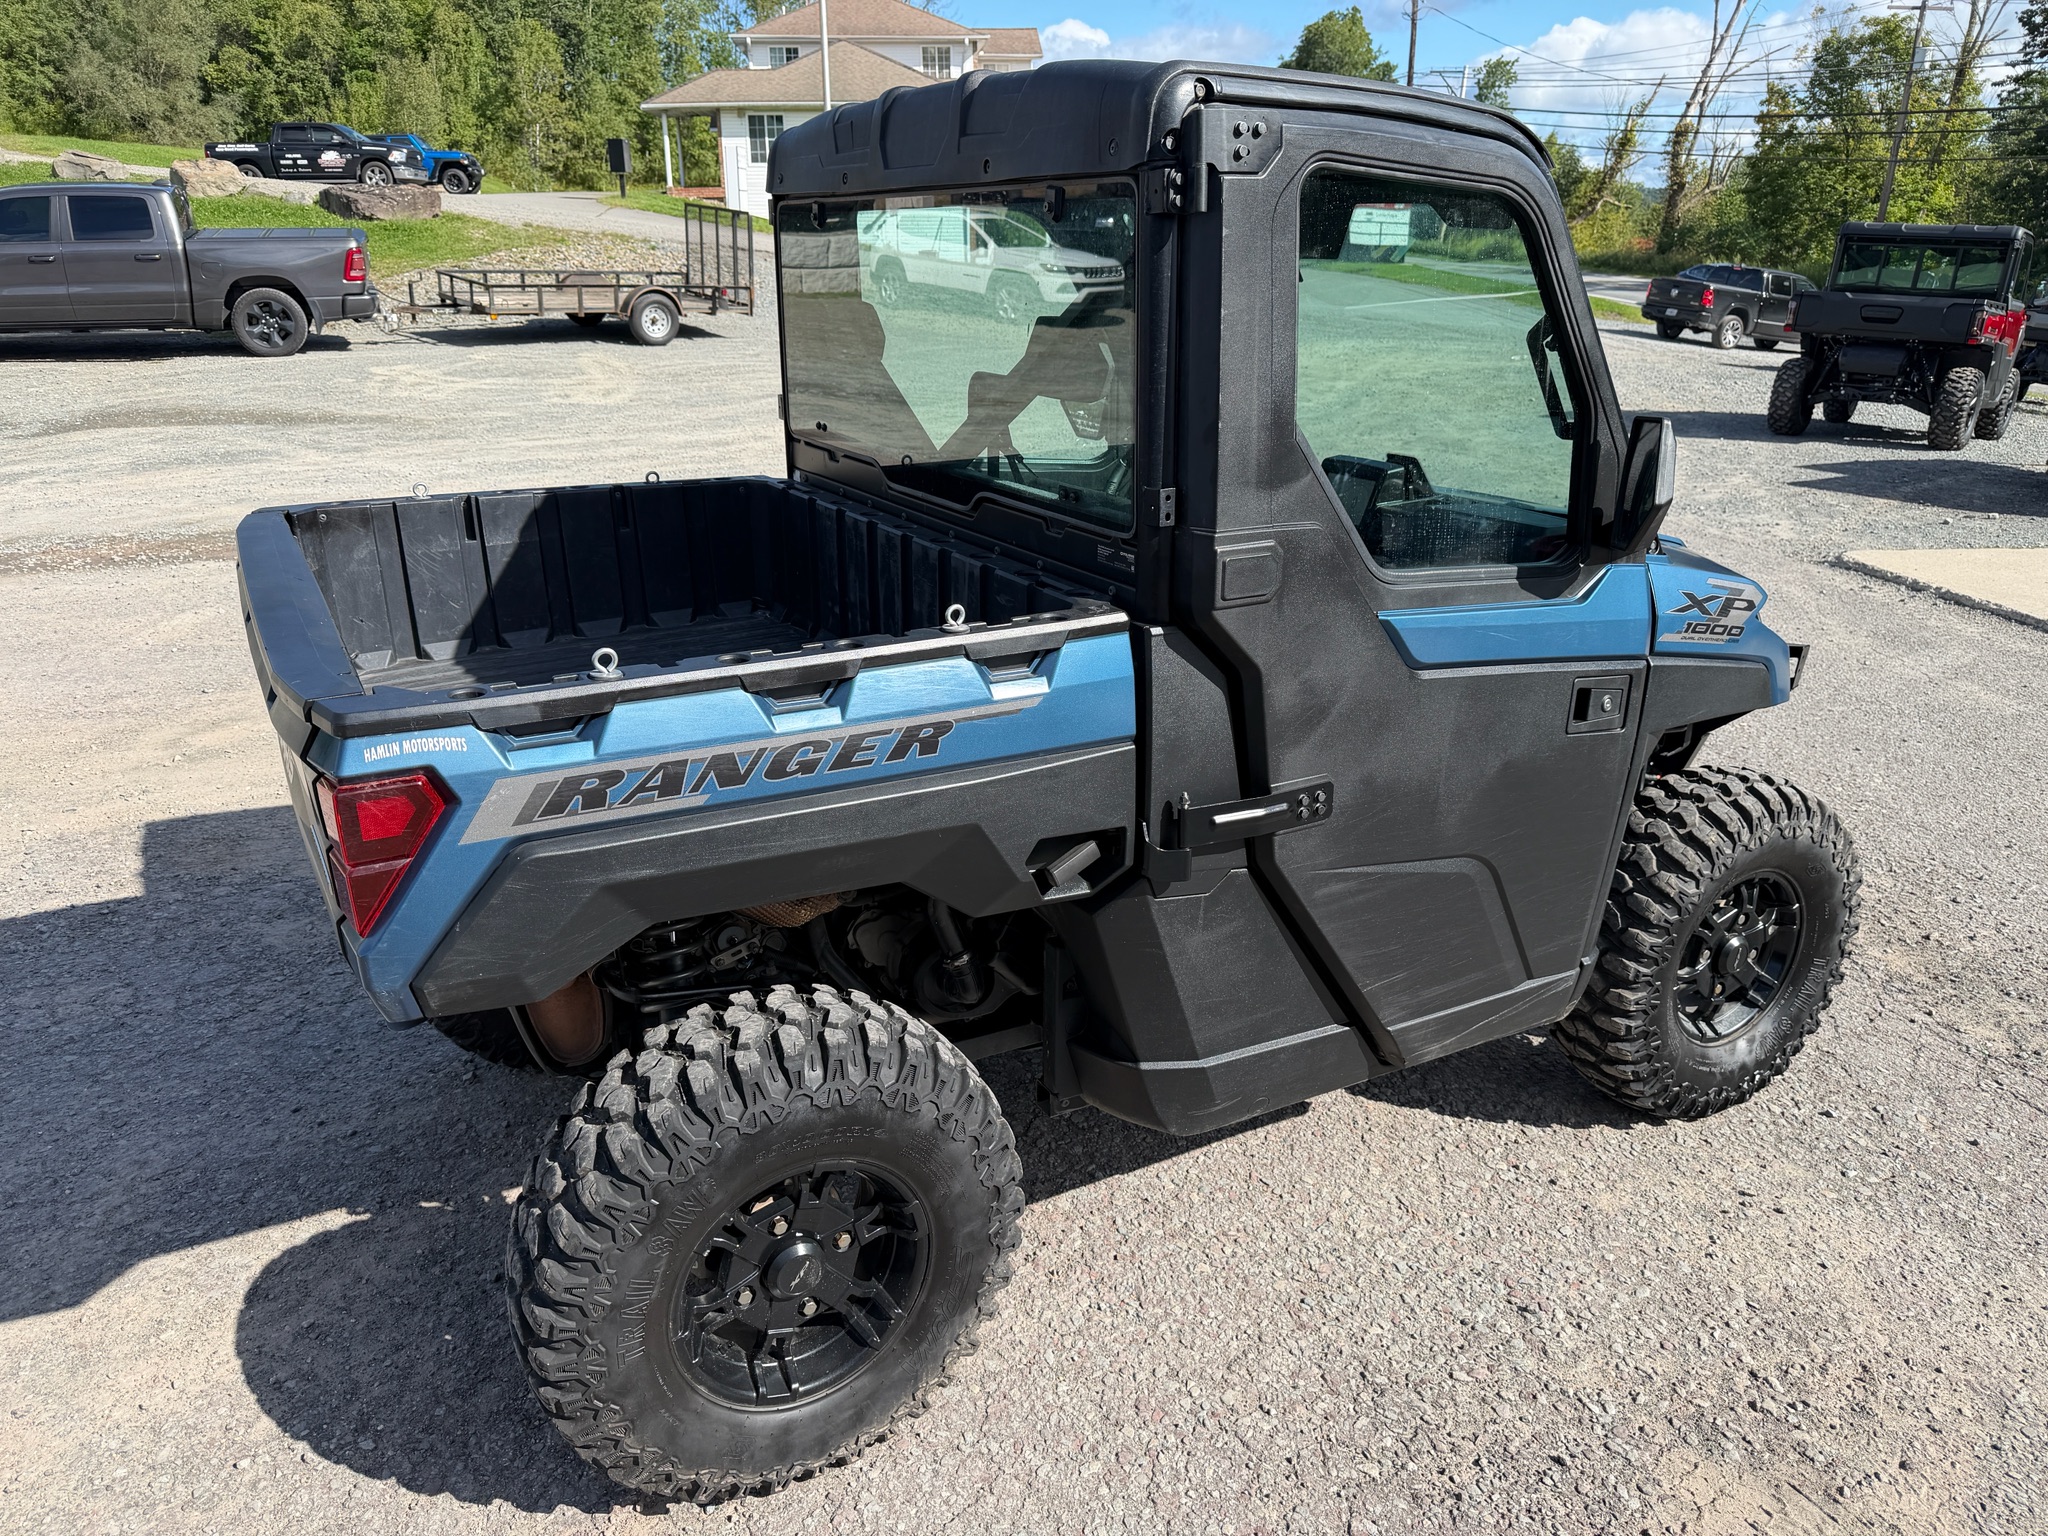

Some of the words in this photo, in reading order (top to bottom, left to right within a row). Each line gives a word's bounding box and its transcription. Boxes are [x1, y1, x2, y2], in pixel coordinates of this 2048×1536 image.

[1663, 589, 1757, 618] XP
[1683, 621, 1745, 637] 1000
[363, 741, 401, 763] HAMLIN
[402, 737, 468, 755] MOTORSPORTS
[532, 719, 956, 822] RANGER
[616, 1268, 662, 1370] TRAIL
